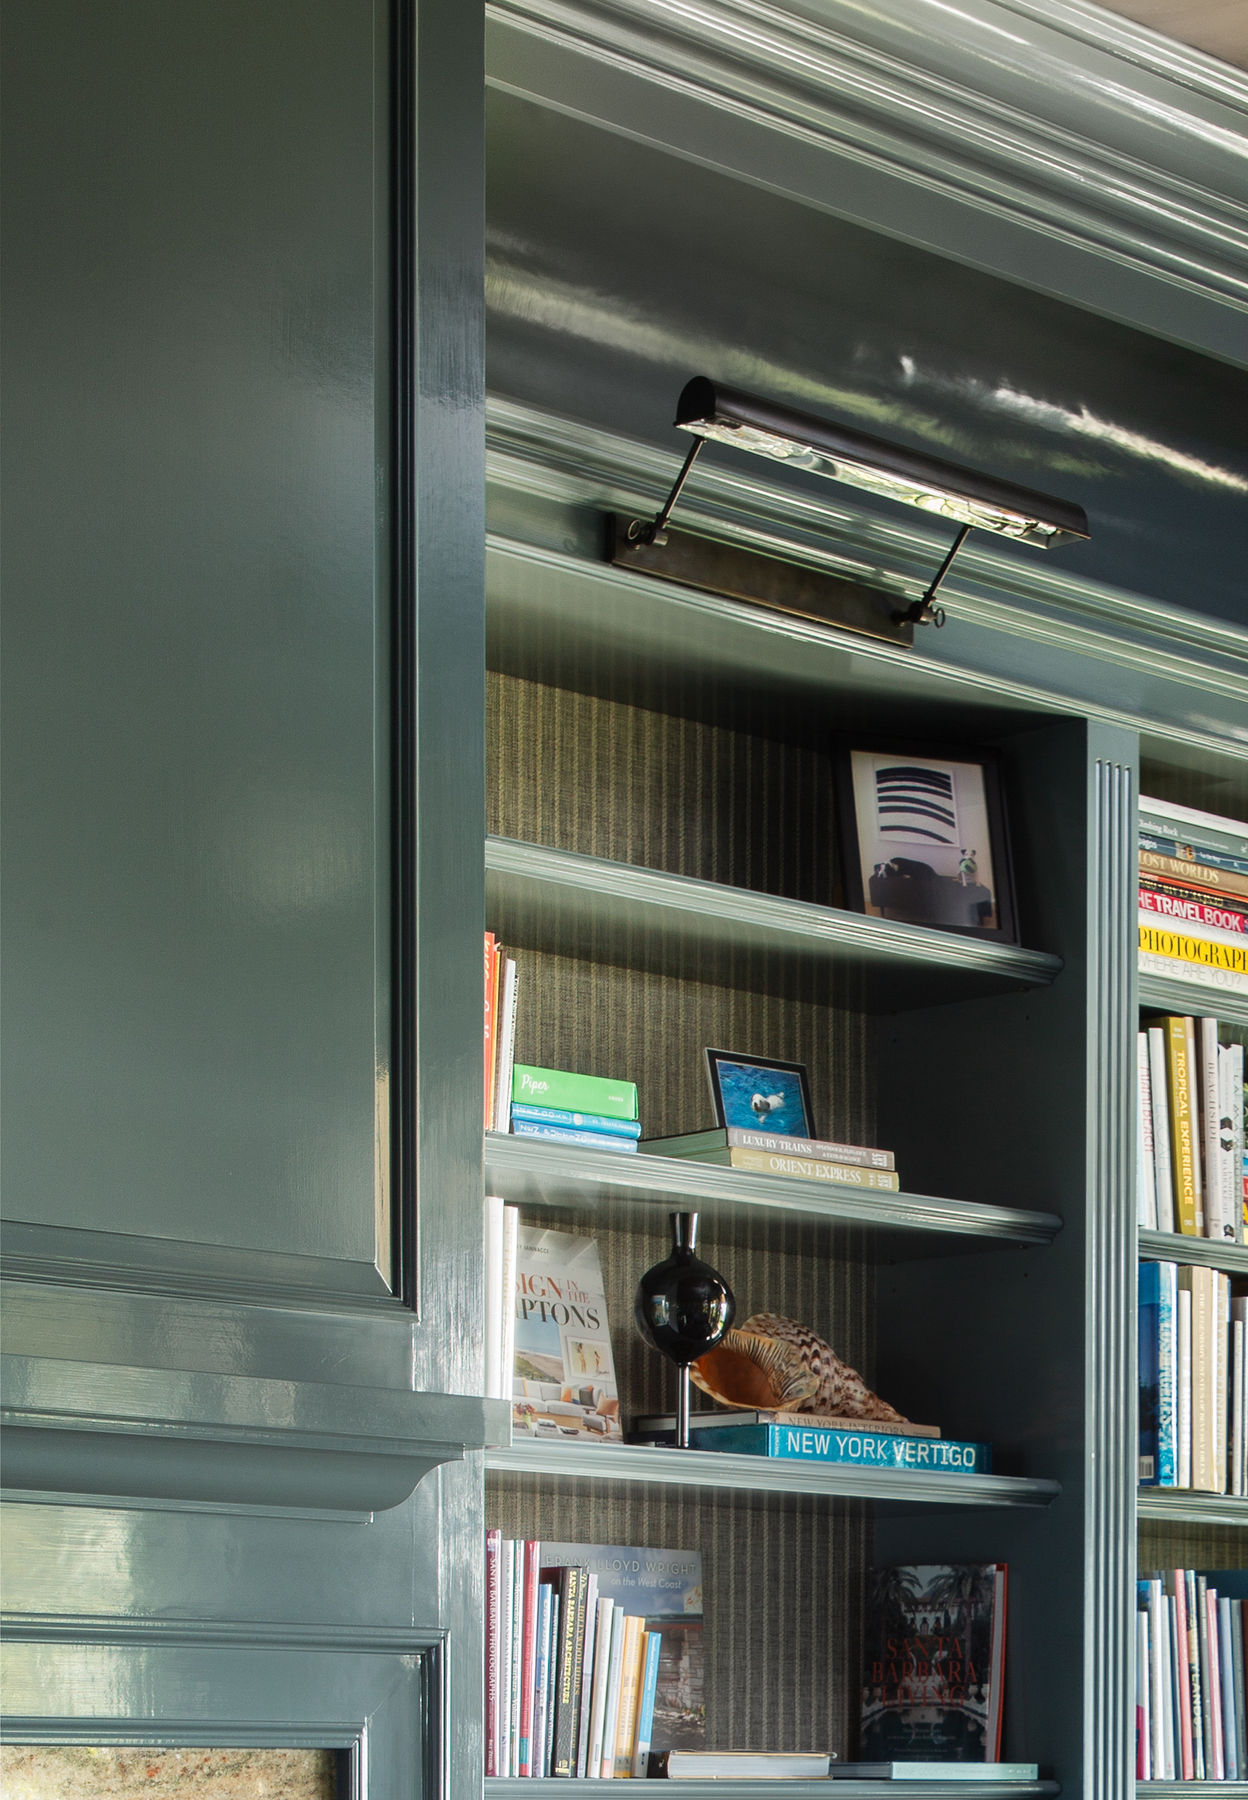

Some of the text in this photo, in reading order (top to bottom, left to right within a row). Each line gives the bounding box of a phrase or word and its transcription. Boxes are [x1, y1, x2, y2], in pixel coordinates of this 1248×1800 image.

[1169, 859, 1220, 884] WORLDS
[1138, 890, 1154, 911] HE
[1154, 894, 1204, 923] TRAVEL
[1204, 907, 1242, 933] BOOK
[1142, 953, 1242, 987] WHERE ARE YOU?
[521, 1074, 550, 1095] Piper
[1208, 1062, 1218, 1143] BEACHSIDE
[1143, 1109, 1155, 1153] BEACH
[1177, 1050, 1194, 1206] TROPICAL EXPERIENCE
[743, 1134, 813, 1155] LUXURY TRAINS
[769, 1157, 814, 1176] ORIENT
[816, 1161, 862, 1184] EXPRESS
[567, 1279, 579, 1291] IN
[568, 1292, 590, 1304] THE
[787, 1431, 830, 1455] NEW
[835, 1435, 888, 1460] YORK
[892, 1440, 976, 1468] VERTIGO
[597, 1558, 641, 1572] LLOYD
[645, 1560, 696, 1574] WRIGHT
[611, 1576, 681, 1589] on the West Coast
[489, 1590, 497, 1627] BARBARA
[562, 1570, 577, 1704] SANTA BARBARA ARCHITECTURE
[885, 1636, 964, 1660] SANTA
[488, 1632, 496, 1701] PHOTOGRAPHS
[871, 1660, 978, 1684] BARBARA
[881, 1685, 966, 1708] LIVING
